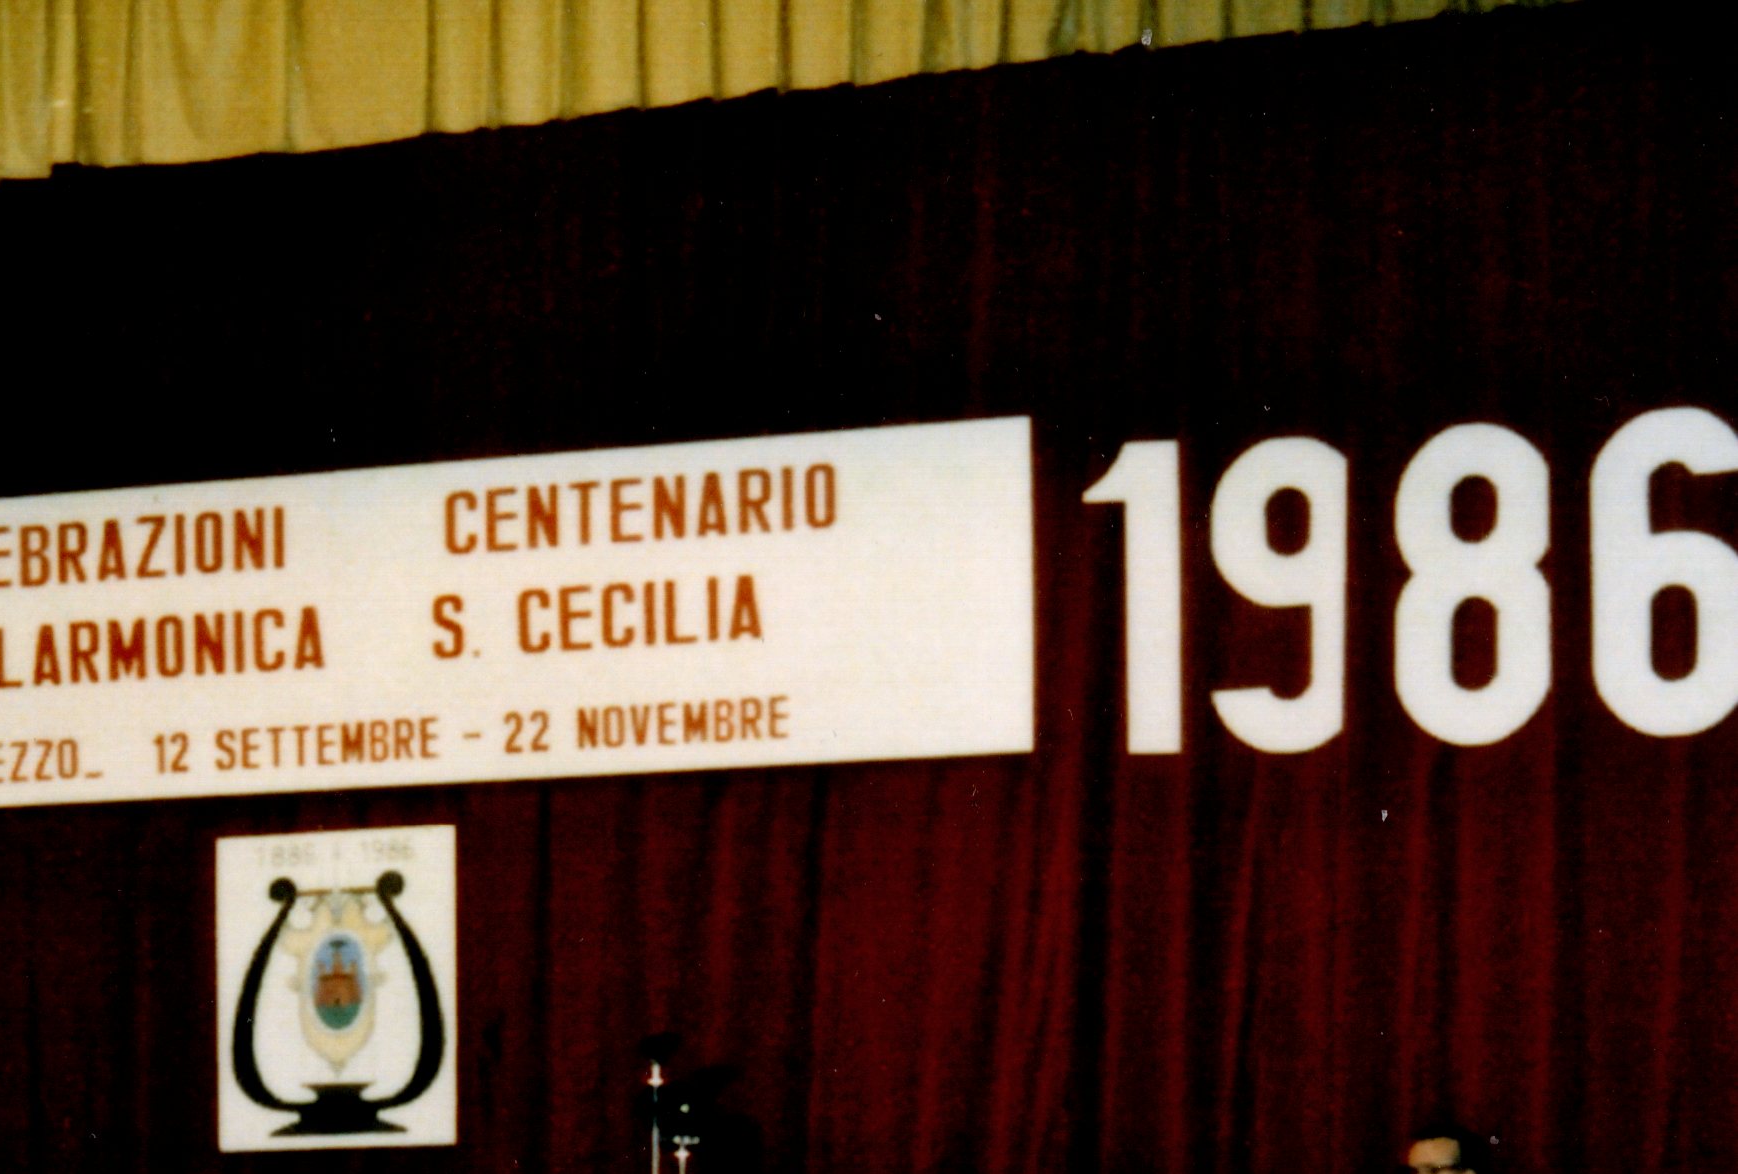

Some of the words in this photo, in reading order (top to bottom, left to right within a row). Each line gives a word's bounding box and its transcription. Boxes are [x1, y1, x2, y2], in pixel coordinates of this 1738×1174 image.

[443, 463, 837, 556] CENTENARIO
[431, 593, 481, 660] S.
[516, 574, 763, 654] CECILIA
[1082, 406, 1738, 754] 1986
[153, 732, 190, 775] 12
[214, 715, 439, 772] SETTEMBRE
[503, 710, 550, 755] 22
[576, 695, 786, 750] NOVEMBRE
